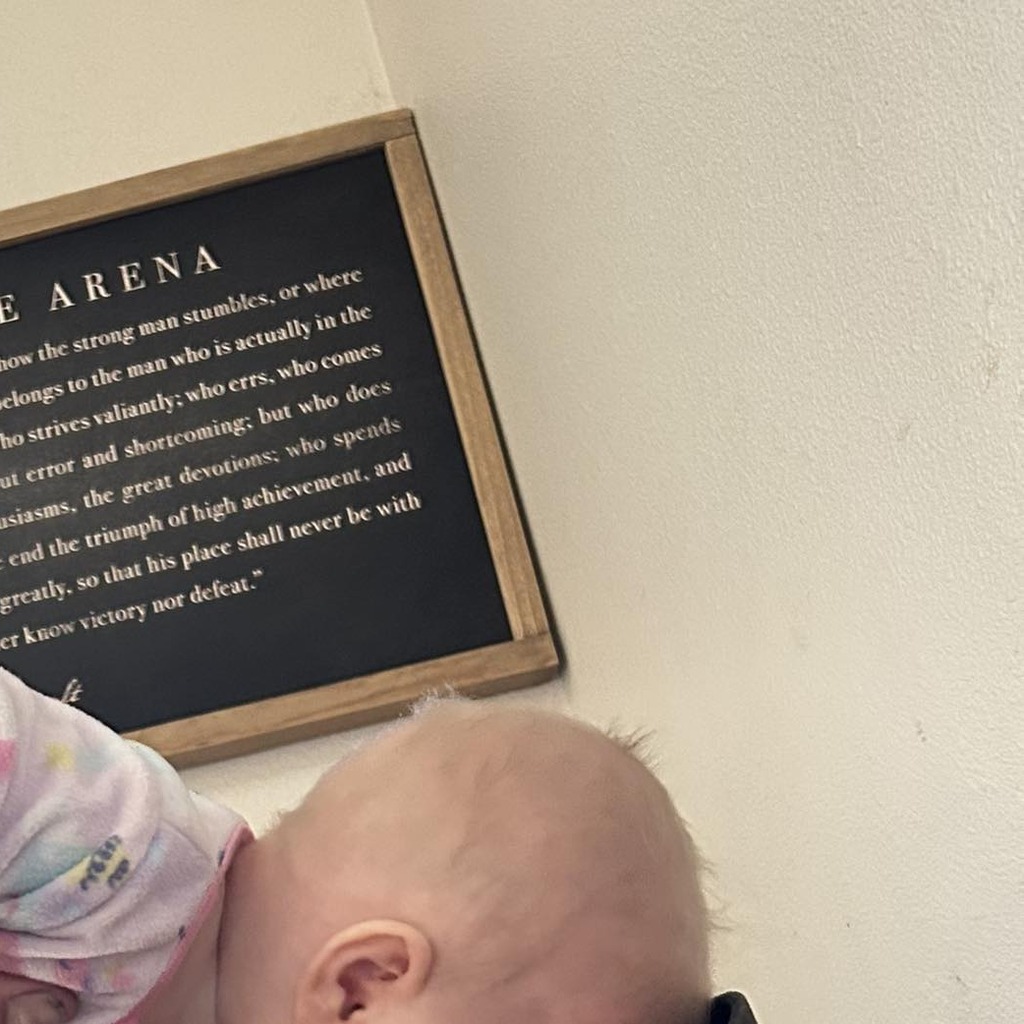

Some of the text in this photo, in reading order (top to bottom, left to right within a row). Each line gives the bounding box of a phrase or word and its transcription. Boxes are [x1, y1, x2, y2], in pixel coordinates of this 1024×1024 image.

[37, 342, 68, 361] the
[72, 326, 135, 353] strong
[137, 315, 180, 336] man
[278, 284, 300, 300] or
[302, 269, 362, 293] where
[49, 245, 221, 311] ARENA
[26, 416, 91, 442] strives
[184, 382, 226, 402] who
[276, 358, 318, 379] who
[320, 344, 382, 369] comes
[67, 378, 89, 393] to
[90, 367, 122, 387] the
[126, 357, 168, 378] man
[169, 345, 211, 366] who
[213, 339, 232, 356] is
[234, 318, 311, 351] actually
[314, 313, 337, 331] in
[339, 305, 371, 325] the
[25, 459, 75, 483] error
[81, 444, 118, 469] and
[257, 405, 292, 425] but
[297, 393, 339, 414] who
[345, 383, 391, 403] does
[82, 488, 114, 508] the
[121, 475, 173, 504] great
[284, 437, 326, 457] who
[332, 416, 401, 449] spends
[8, 542, 45, 567] end
[48, 537, 80, 557] the
[84, 514, 164, 548] triumph
[167, 505, 189, 527] of
[191, 496, 237, 523] high
[373, 451, 412, 477] and
[76, 575, 99, 591] so
[103, 563, 142, 584] that
[145, 555, 177, 574] his
[180, 542, 232, 571] place
[236, 524, 284, 551] shall
[288, 514, 342, 539] never
[345, 506, 371, 525] be
[375, 491, 421, 516] with
[22, 623, 74, 644] know
[78, 605, 146, 630] victory
[151, 593, 185, 614] nor
